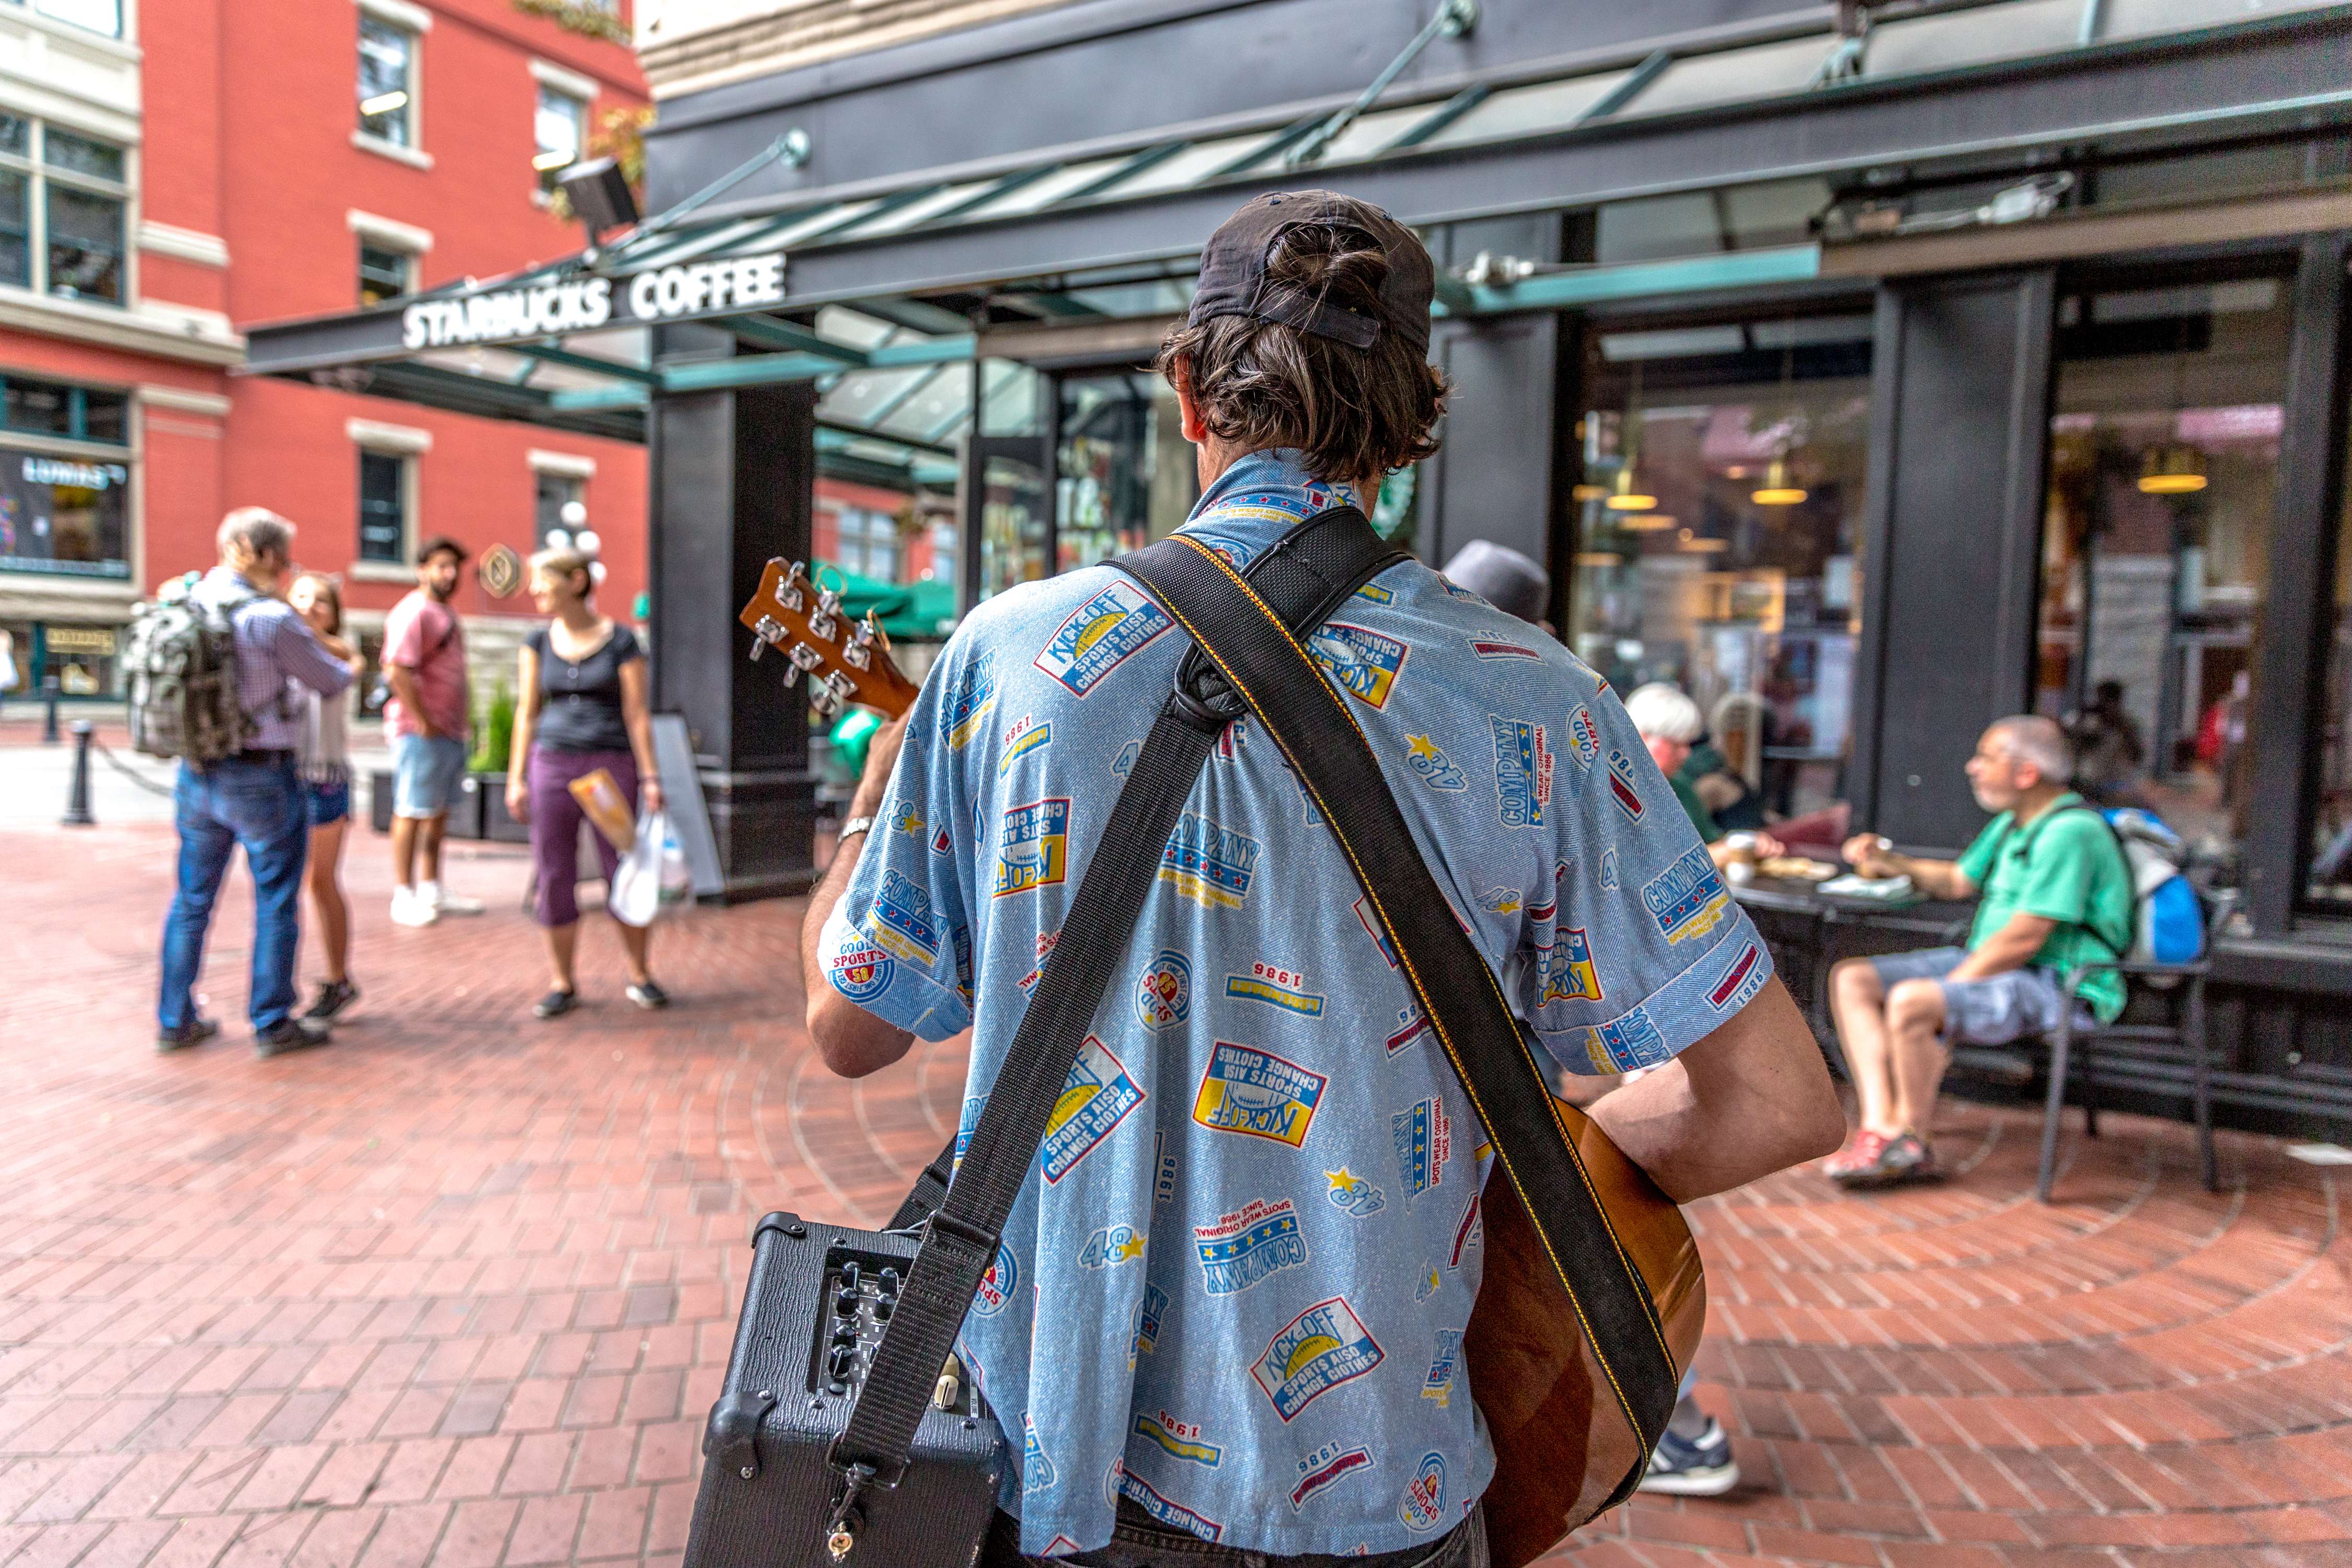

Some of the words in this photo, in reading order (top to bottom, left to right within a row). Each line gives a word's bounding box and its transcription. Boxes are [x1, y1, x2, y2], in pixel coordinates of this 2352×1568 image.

[402, 278, 612, 350] STARBUCKS
[630, 252, 786, 320] COFFEE
[1047, 589, 1129, 664] KICK-OFF
[1348, 629, 1401, 658] CHANGE
[1075, 633, 1121, 673] SPORTS
[1076, 648, 1124, 689] CHANGE
[1005, 716, 1030, 745] 1986
[1409, 752, 1466, 789] 48
[1491, 716, 1527, 826] COMPANY
[875, 934, 894, 950] SINCE
[883, 927, 904, 944] WEAR
[904, 942, 933, 965] ORIGINAL
[1668, 925, 1691, 944] SPOTS
[1691, 923, 1712, 939] SINCE
[834, 950, 886, 967] SPORTS
[852, 967, 869, 982] 58
[1254, 963, 1301, 987] 1986
[1737, 973, 1763, 1004] 1986
[1250, 1070, 1302, 1098] SPORTS
[1266, 1059, 1318, 1091] CHANGE
[1205, 1083, 1299, 1136] KICK-OFF
[1046, 1112, 1093, 1156] SPORTS
[1047, 1130, 1096, 1175] CHANGE
[1159, 1158, 1176, 1201] 1986
[1242, 1200, 1263, 1216] SINCE
[1262, 1201, 1290, 1216] SPOTS
[1330, 1180, 1385, 1216] 48
[1195, 1223, 1240, 1237] ORIGINAL
[1220, 1213, 1240, 1224] 1986
[1241, 1212, 1262, 1227] WEAR
[1080, 1226, 1133, 1267] 48
[1204, 1235, 1306, 1294] COMPANY
[1265, 1306, 1344, 1382] KICK-OFF
[1283, 1375, 1327, 1414] CHANGE
[1284, 1359, 1329, 1397] SPORTS
[1160, 1410, 1198, 1437] 1986
[1298, 1442, 1339, 1472] 1986
[1411, 1480, 1438, 1520] SPORTS
[1165, 1506, 1214, 1542] CHANGE
